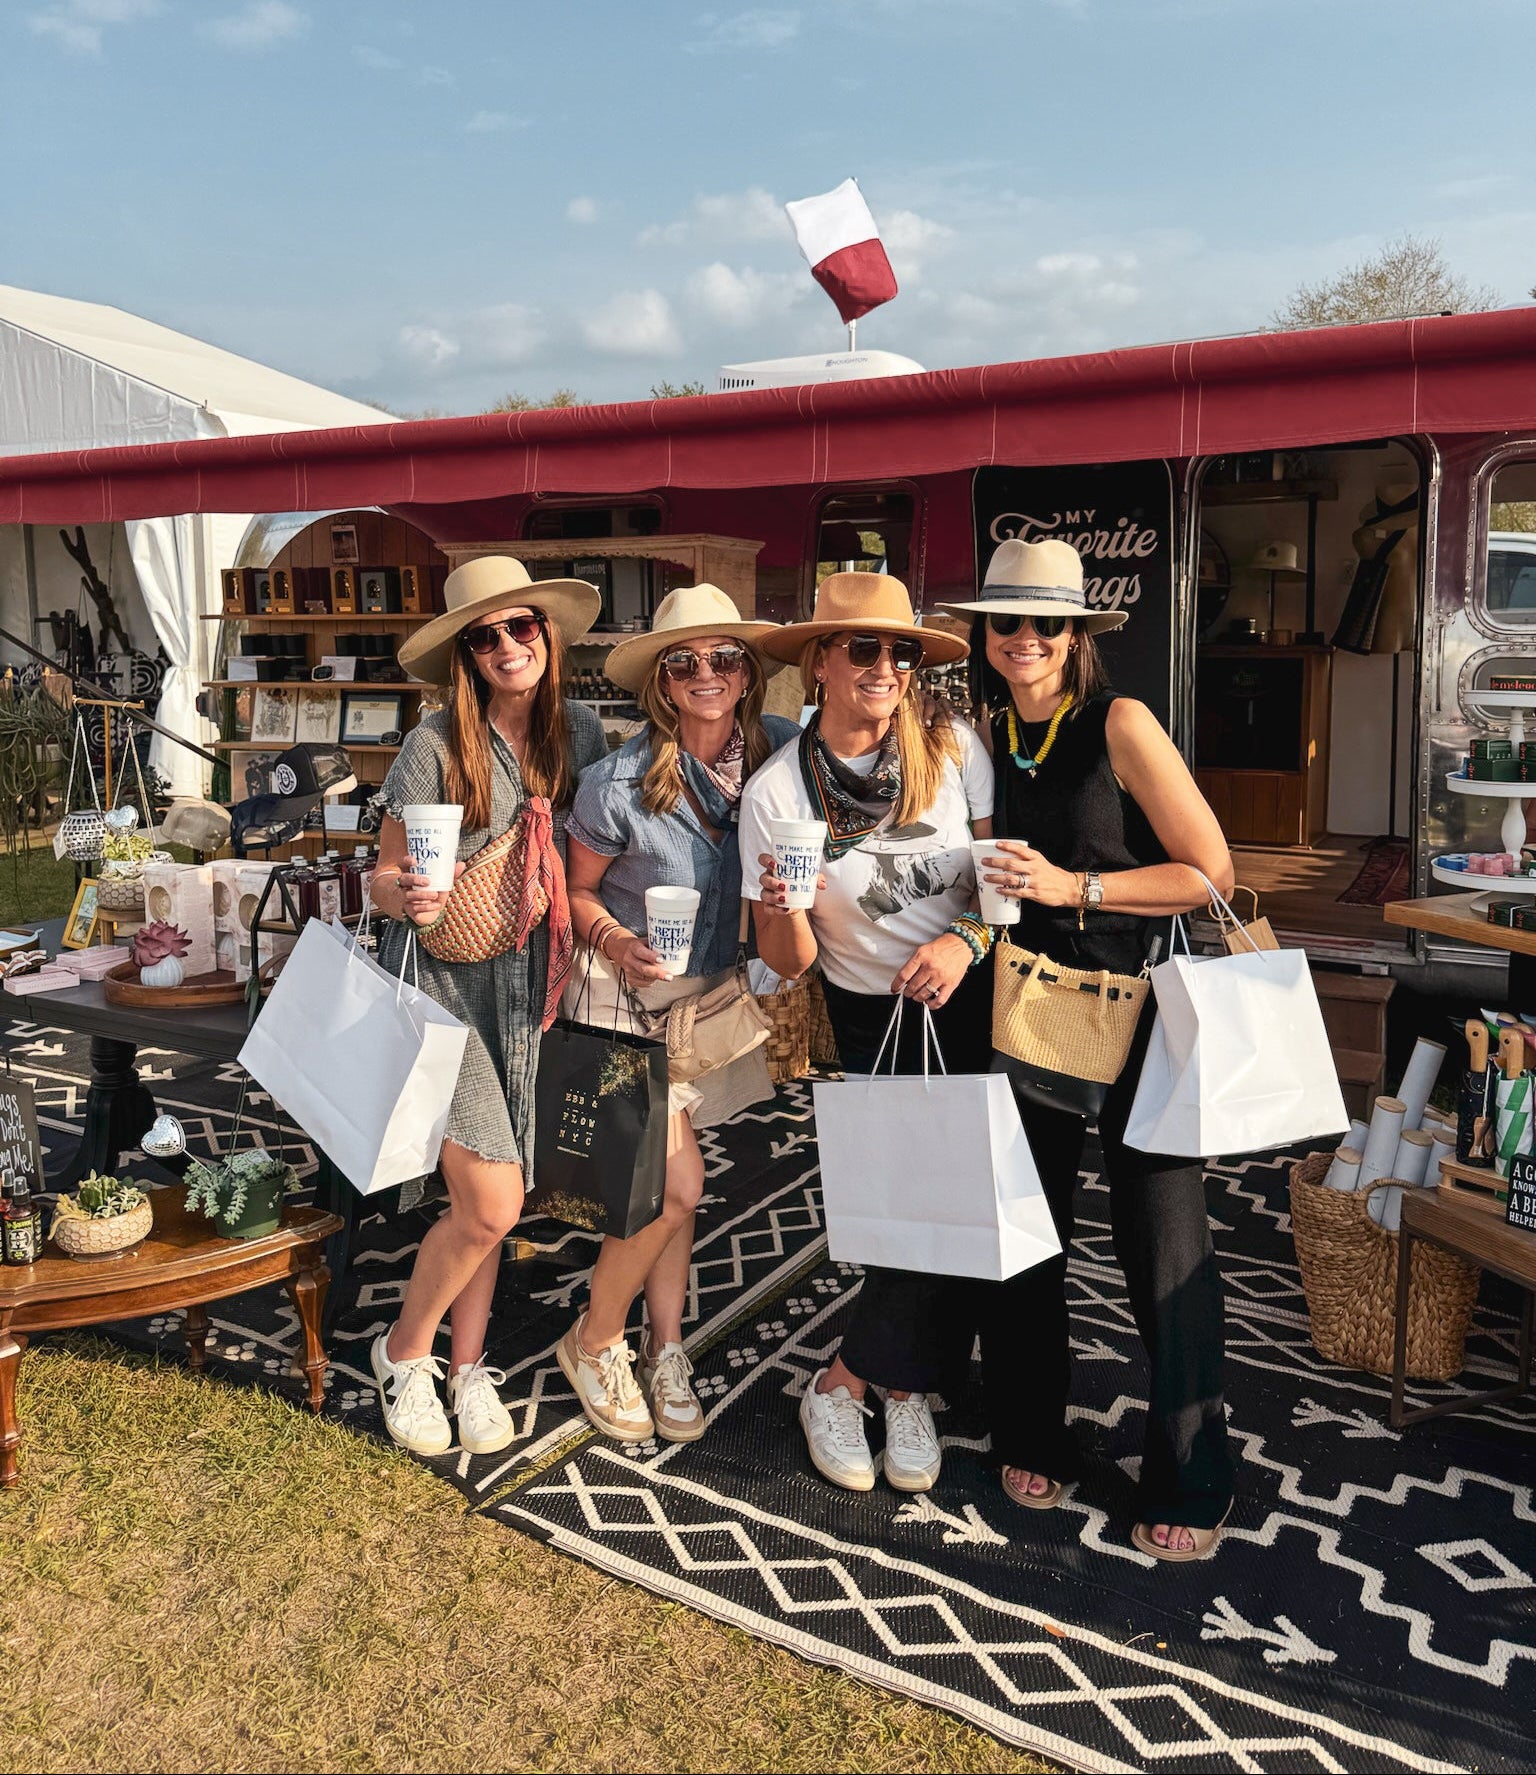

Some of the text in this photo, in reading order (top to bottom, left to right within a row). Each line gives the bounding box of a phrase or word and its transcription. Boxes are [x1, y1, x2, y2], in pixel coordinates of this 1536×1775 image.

[1065, 509, 1096, 524] MY
[785, 854, 817, 866] BETH
[789, 884, 798, 892] ON
[655, 926, 685, 937] BETH
[649, 933, 691, 951] DUTTON
[565, 1092, 599, 1109] EBB &
[562, 1111, 596, 1129] FLOW
[1512, 1161, 1521, 1178] A
[1509, 1192, 1519, 1210] A
